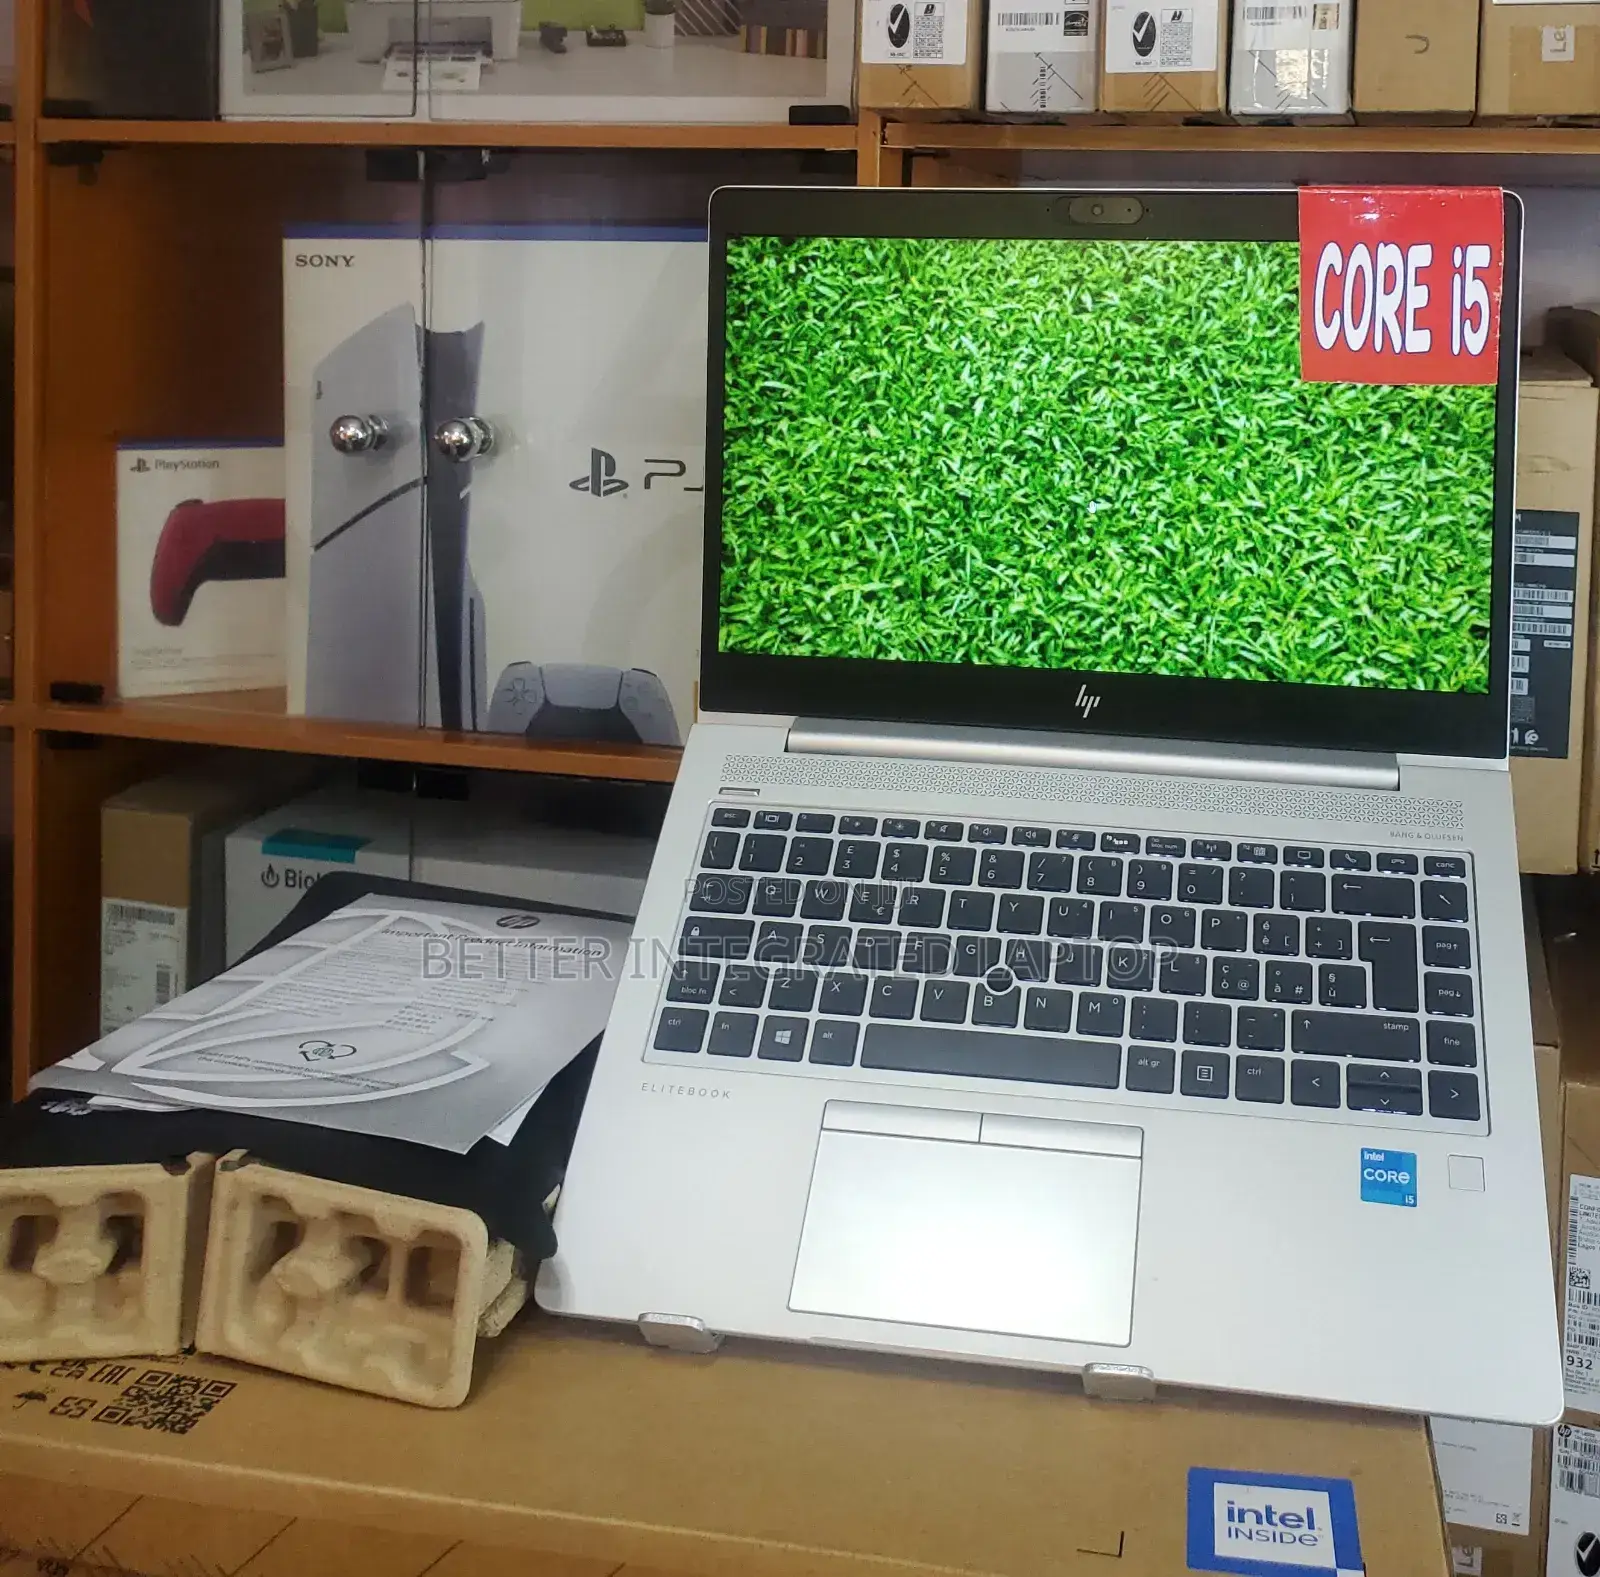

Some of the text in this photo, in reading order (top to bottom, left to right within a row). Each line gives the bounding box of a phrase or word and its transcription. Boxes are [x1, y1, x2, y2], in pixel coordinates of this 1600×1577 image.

[295, 254, 356, 268] SONY
[1313, 241, 1491, 356] CORE i5
[154, 458, 220, 473] PlayStation
[1074, 684, 1101, 719] hp
[1389, 830, 1414, 839] BANG
[1424, 832, 1464, 842] OLUFSEN
[893, 849, 900, 858] $
[940, 852, 950, 862] %
[988, 854, 997, 863] &
[794, 857, 803, 866] 2
[842, 860, 851, 869] 3
[1087, 860, 1093, 871] (
[1435, 860, 1456, 869] canc
[890, 863, 898, 872] 4
[939, 867, 947, 876] 5
[1137, 864, 1143, 875] )
[285, 868, 320, 889] Bio
[987, 870, 996, 879] 6
[1037, 873, 1045, 883] 7
[1239, 872, 1246, 881] ?
[1086, 877, 1095, 886] 8
[1136, 881, 1146, 890] 9
[765, 885, 776, 895] Q
[815, 888, 828, 899] W
[1187, 885, 1196, 894] 0
[861, 891, 870, 901] E
[909, 895, 919, 905] R
[959, 898, 968, 909] T
[1009, 902, 1020, 912] Y
[1058, 906, 1069, 916] U
[1160, 914, 1172, 924] O
[1211, 918, 1221, 928] P
[1262, 920, 1270, 931] é
[767, 930, 777, 939] A
[817, 933, 825, 944] S
[381, 928, 603, 957] Important Product Information
[865, 937, 875, 947] D
[915, 940, 923, 950] F
[1435, 941, 1452, 951] pag
[966, 944, 976, 955] G
[1016, 948, 1025, 958] H
[1066, 952, 1074, 963] J
[1118, 957, 1128, 967] K
[1170, 961, 1179, 972] L
[781, 977, 791, 988] Z
[830, 981, 841, 992] X
[1238, 979, 1249, 990] @
[681, 986, 697, 995] bloc
[882, 985, 892, 996] C
[933, 989, 944, 1000] V
[1294, 985, 1303, 994] #
[1438, 988, 1454, 997] pag
[983, 996, 993, 1007] B
[1035, 997, 1047, 1008] N
[1088, 1002, 1100, 1013] M
[668, 1018, 682, 1026] ctrl
[721, 1022, 730, 1030] fn
[1383, 1022, 1409, 1032] stamp
[822, 1031, 834, 1039] alt
[1443, 1037, 1460, 1046] fine
[1138, 1058, 1160, 1068] alt gr
[1247, 1067, 1262, 1076] ctrl
[641, 1082, 731, 1099] ELITEBOOK
[1363, 1150, 1385, 1162] intel
[1405, 1194, 1415, 1205] i5
[1566, 1355, 1593, 1370] 932
[1226, 1500, 1316, 1531] intel
